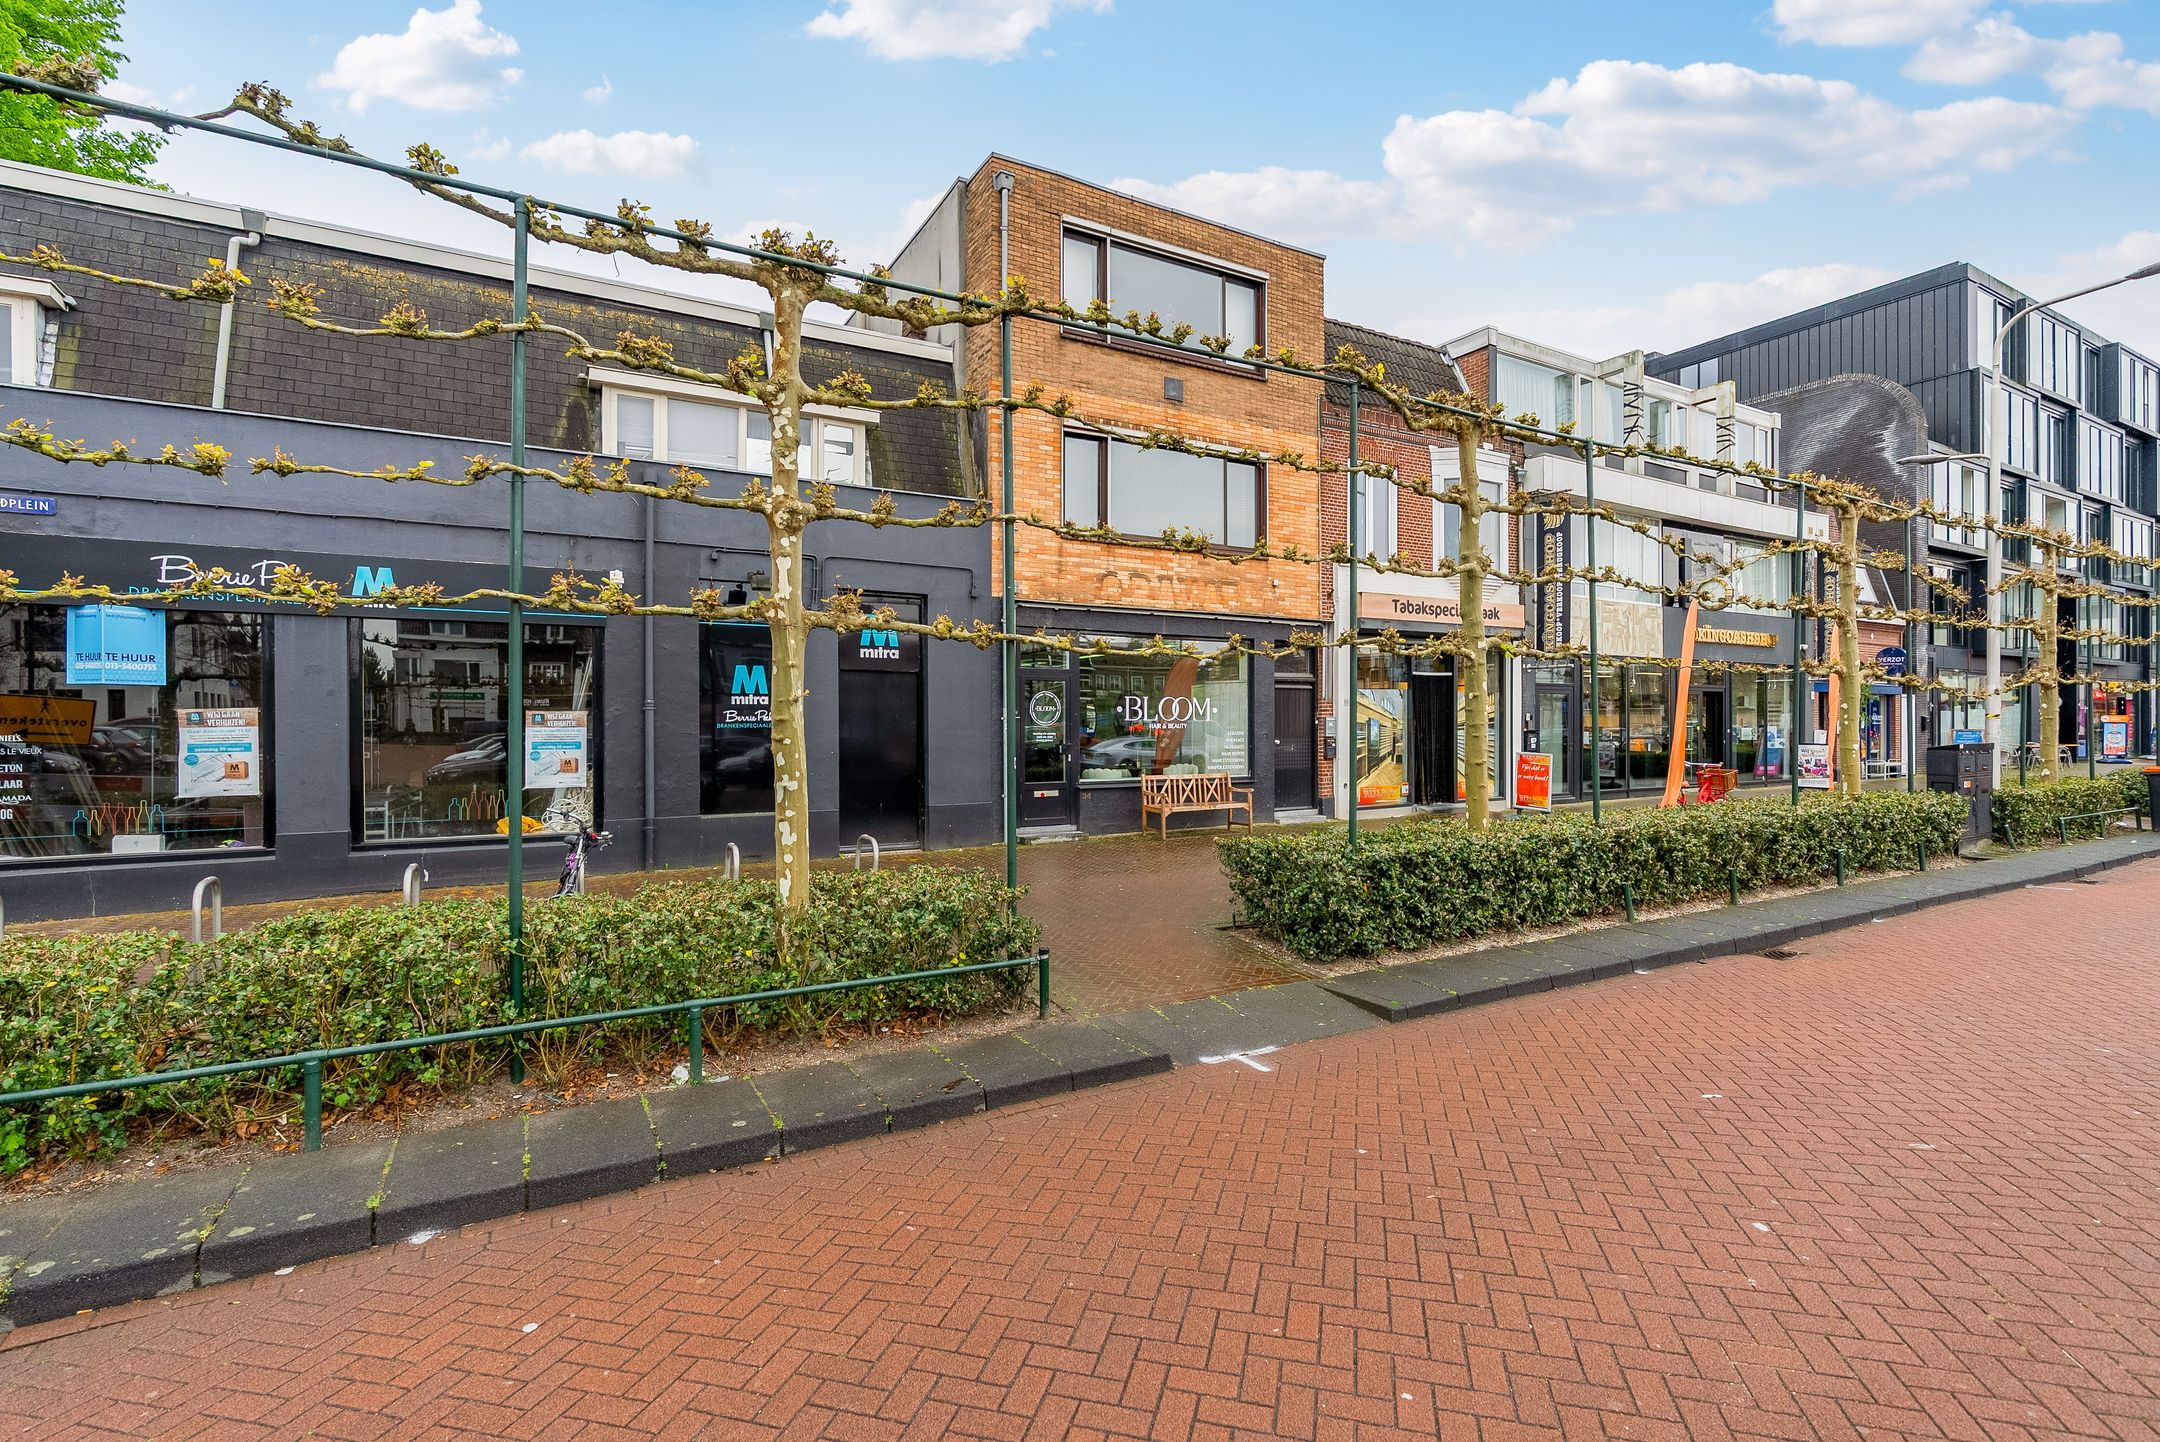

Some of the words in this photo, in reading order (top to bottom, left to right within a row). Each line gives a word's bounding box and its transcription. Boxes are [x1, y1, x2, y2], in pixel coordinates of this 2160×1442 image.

[352, 566, 394, 597] M
[1392, 599, 1500, 620] Tabakspeciaak
[105, 652, 118, 661] TE
[121, 653, 156, 663] HUUR
[860, 646, 899, 659] mitra
[105, 661, 157, 671] 013-5400755
[731, 665, 769, 694] M
[731, 694, 769, 705] mitra
[207, 710, 220, 718] WIJ
[221, 710, 240, 718] GAAN
[1124, 695, 1212, 722] BLOOM
[723, 709, 757, 722] Berrie
[207, 719, 246, 727] VERHUIZEN!
[7, 747, 17, 755] LE
[18, 747, 43, 755] VIEUX
